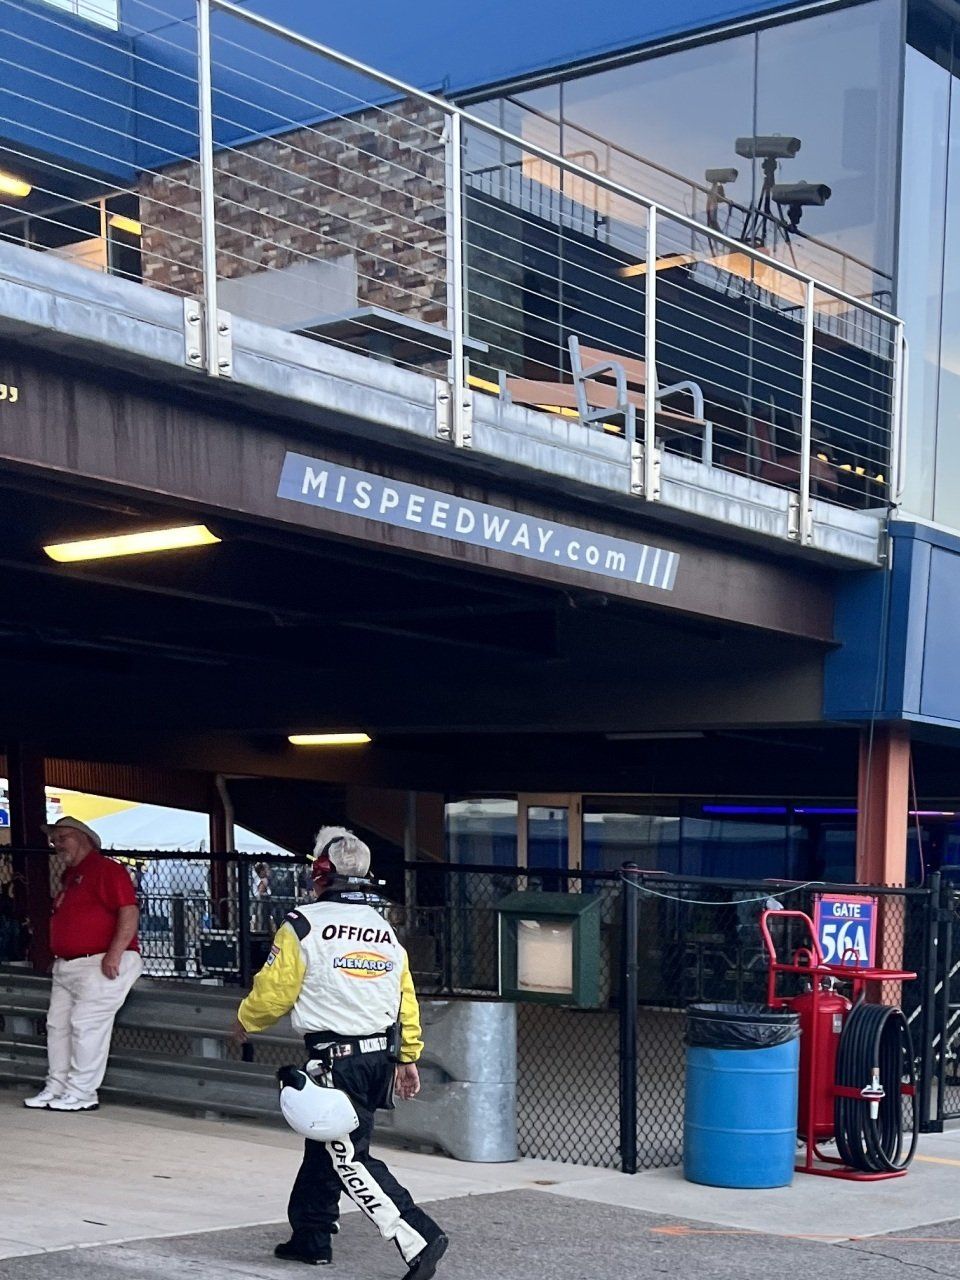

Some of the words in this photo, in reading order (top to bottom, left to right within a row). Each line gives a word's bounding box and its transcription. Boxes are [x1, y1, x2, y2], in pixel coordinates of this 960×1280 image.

[301, 466, 627, 572] MISPEEDWAY.com
[832, 902, 862, 918] GATE
[321, 924, 395, 946] OFFICIA
[821, 920, 869, 964] 56A
[333, 956, 394, 972] MENARDS
[330, 1140, 383, 1216] OFFICIAL
